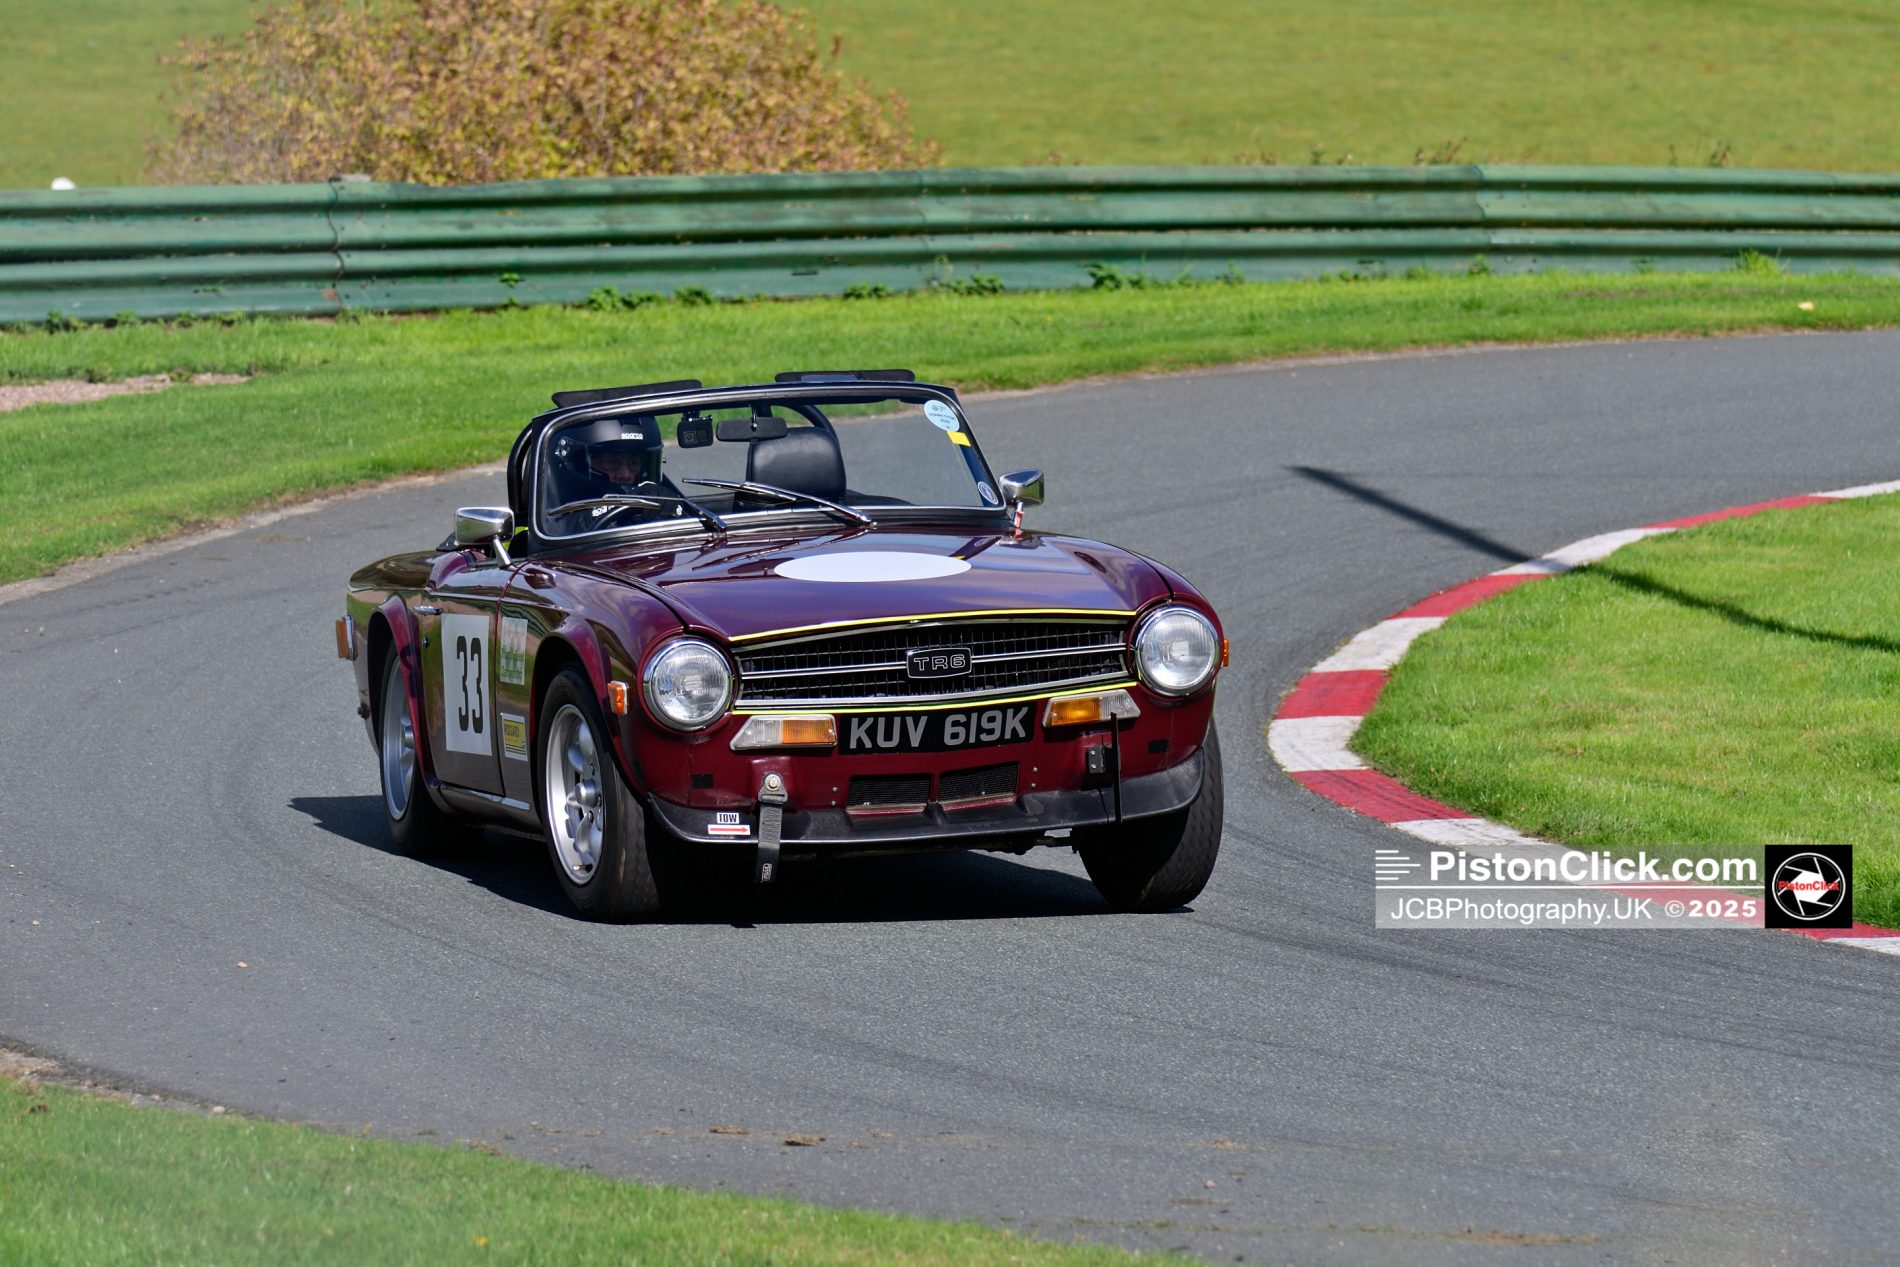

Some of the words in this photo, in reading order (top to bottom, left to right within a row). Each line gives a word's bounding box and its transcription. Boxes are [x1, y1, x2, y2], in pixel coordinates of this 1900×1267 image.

[913, 653, 966, 672] TR6
[456, 635, 483, 734] 33
[850, 715, 928, 749] KUV
[943, 706, 1029, 746] 619K
[719, 813, 738, 823] TOW
